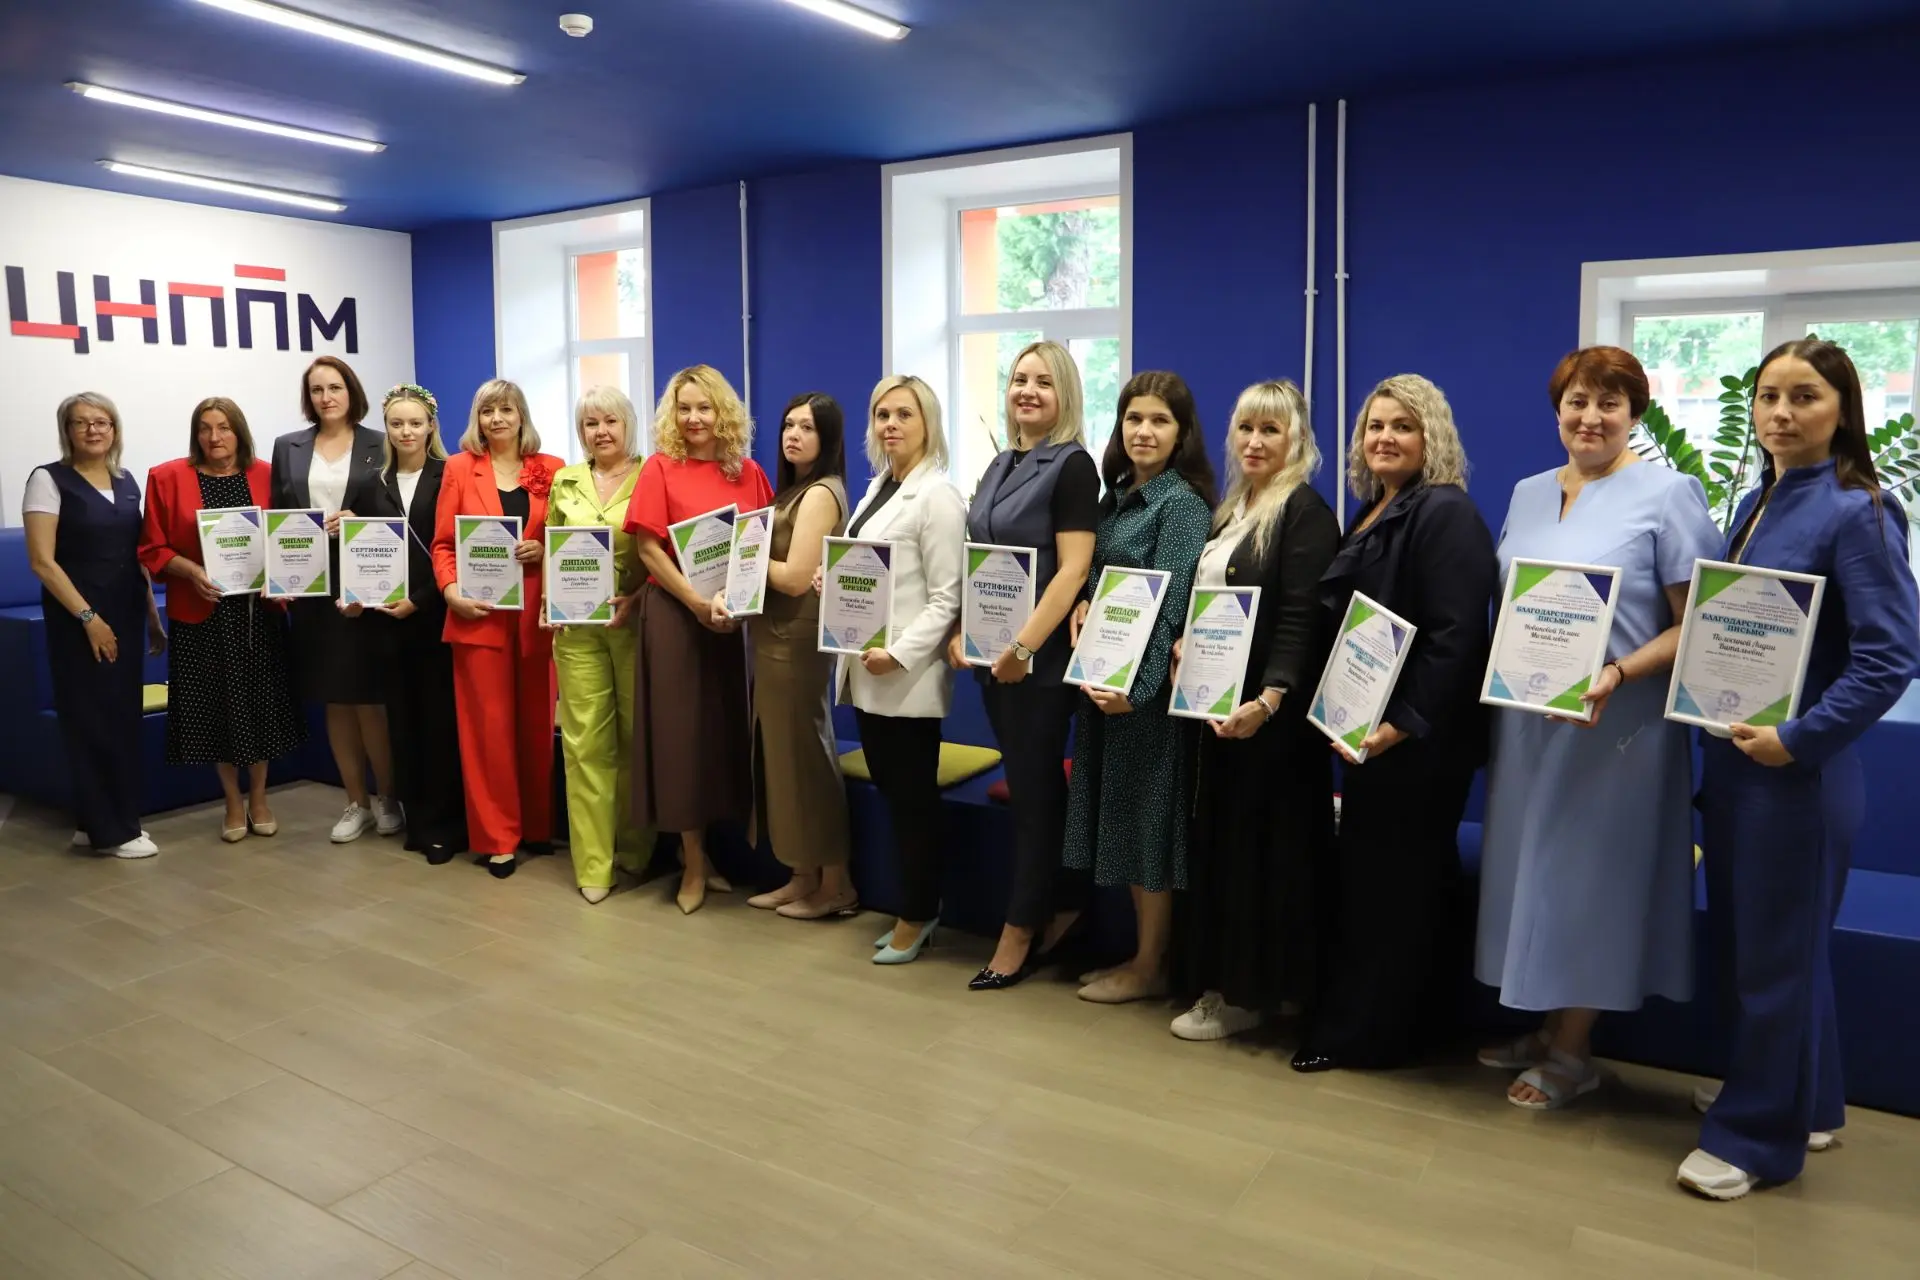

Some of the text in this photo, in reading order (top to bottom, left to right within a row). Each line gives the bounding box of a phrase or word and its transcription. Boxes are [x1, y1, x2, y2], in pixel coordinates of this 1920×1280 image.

[5, 263, 358, 354] ЦНППМ
[278, 537, 313, 545] ДИПЛОМ
[695, 541, 731, 559] ДИПЛОМ
[838, 575, 877, 587] ДИПЛОМ
[973, 581, 1023, 593] СЕРТИФИКАТ
[979, 589, 1016, 599] УЧАСТНИКА
[1104, 605, 1140, 618] ДИПЛОМ
[1516, 605, 1597, 622] БЛАГОДАРСТВЕННОЕ
[1537, 615, 1571, 625] ПИСЬМО
[1702, 613, 1796, 635] БЛАГОДАРСТВЕННОЕ
[1726, 624, 1766, 637] ПИСЬМО
